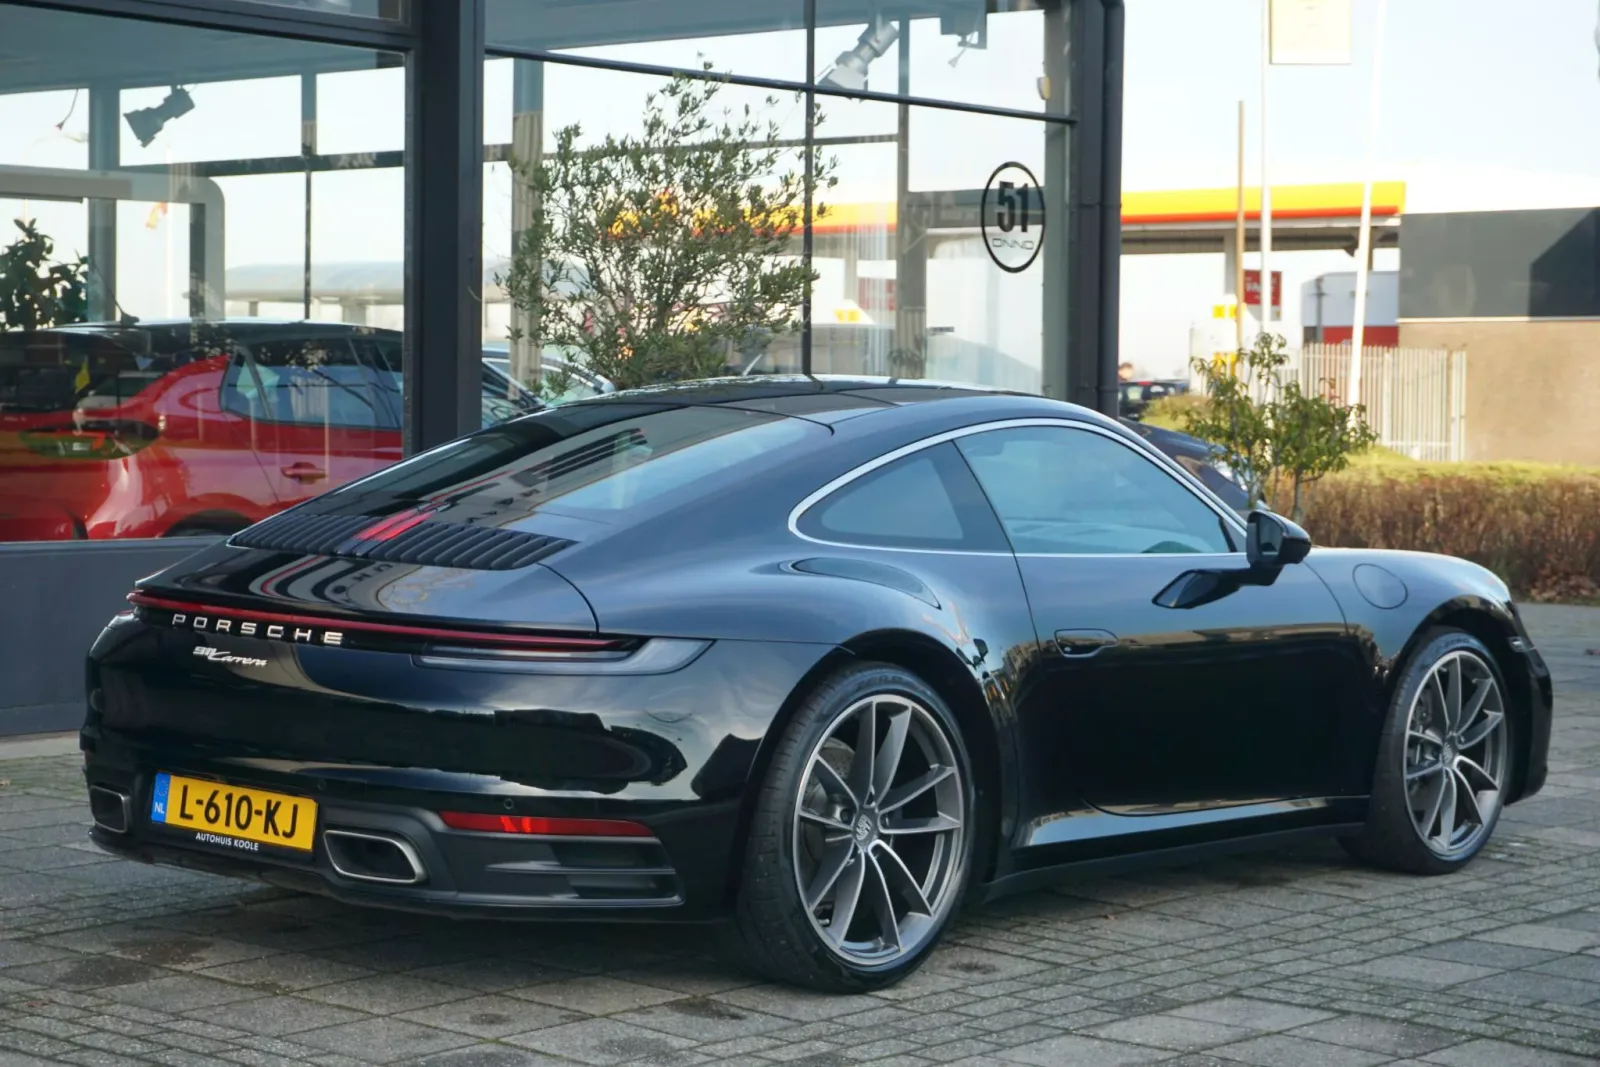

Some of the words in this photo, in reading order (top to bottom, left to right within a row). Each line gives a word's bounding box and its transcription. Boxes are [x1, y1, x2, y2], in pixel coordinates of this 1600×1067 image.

[998, 181, 1028, 233] 51
[172, 613, 342, 644] PORSCHE
[207, 651, 268, 667] Carrera
[154, 802, 165, 814] NL
[179, 785, 298, 839] L-610-KJ
[195, 832, 232, 846] AUTOHUIS
[233, 839, 259, 851] KOOLE
